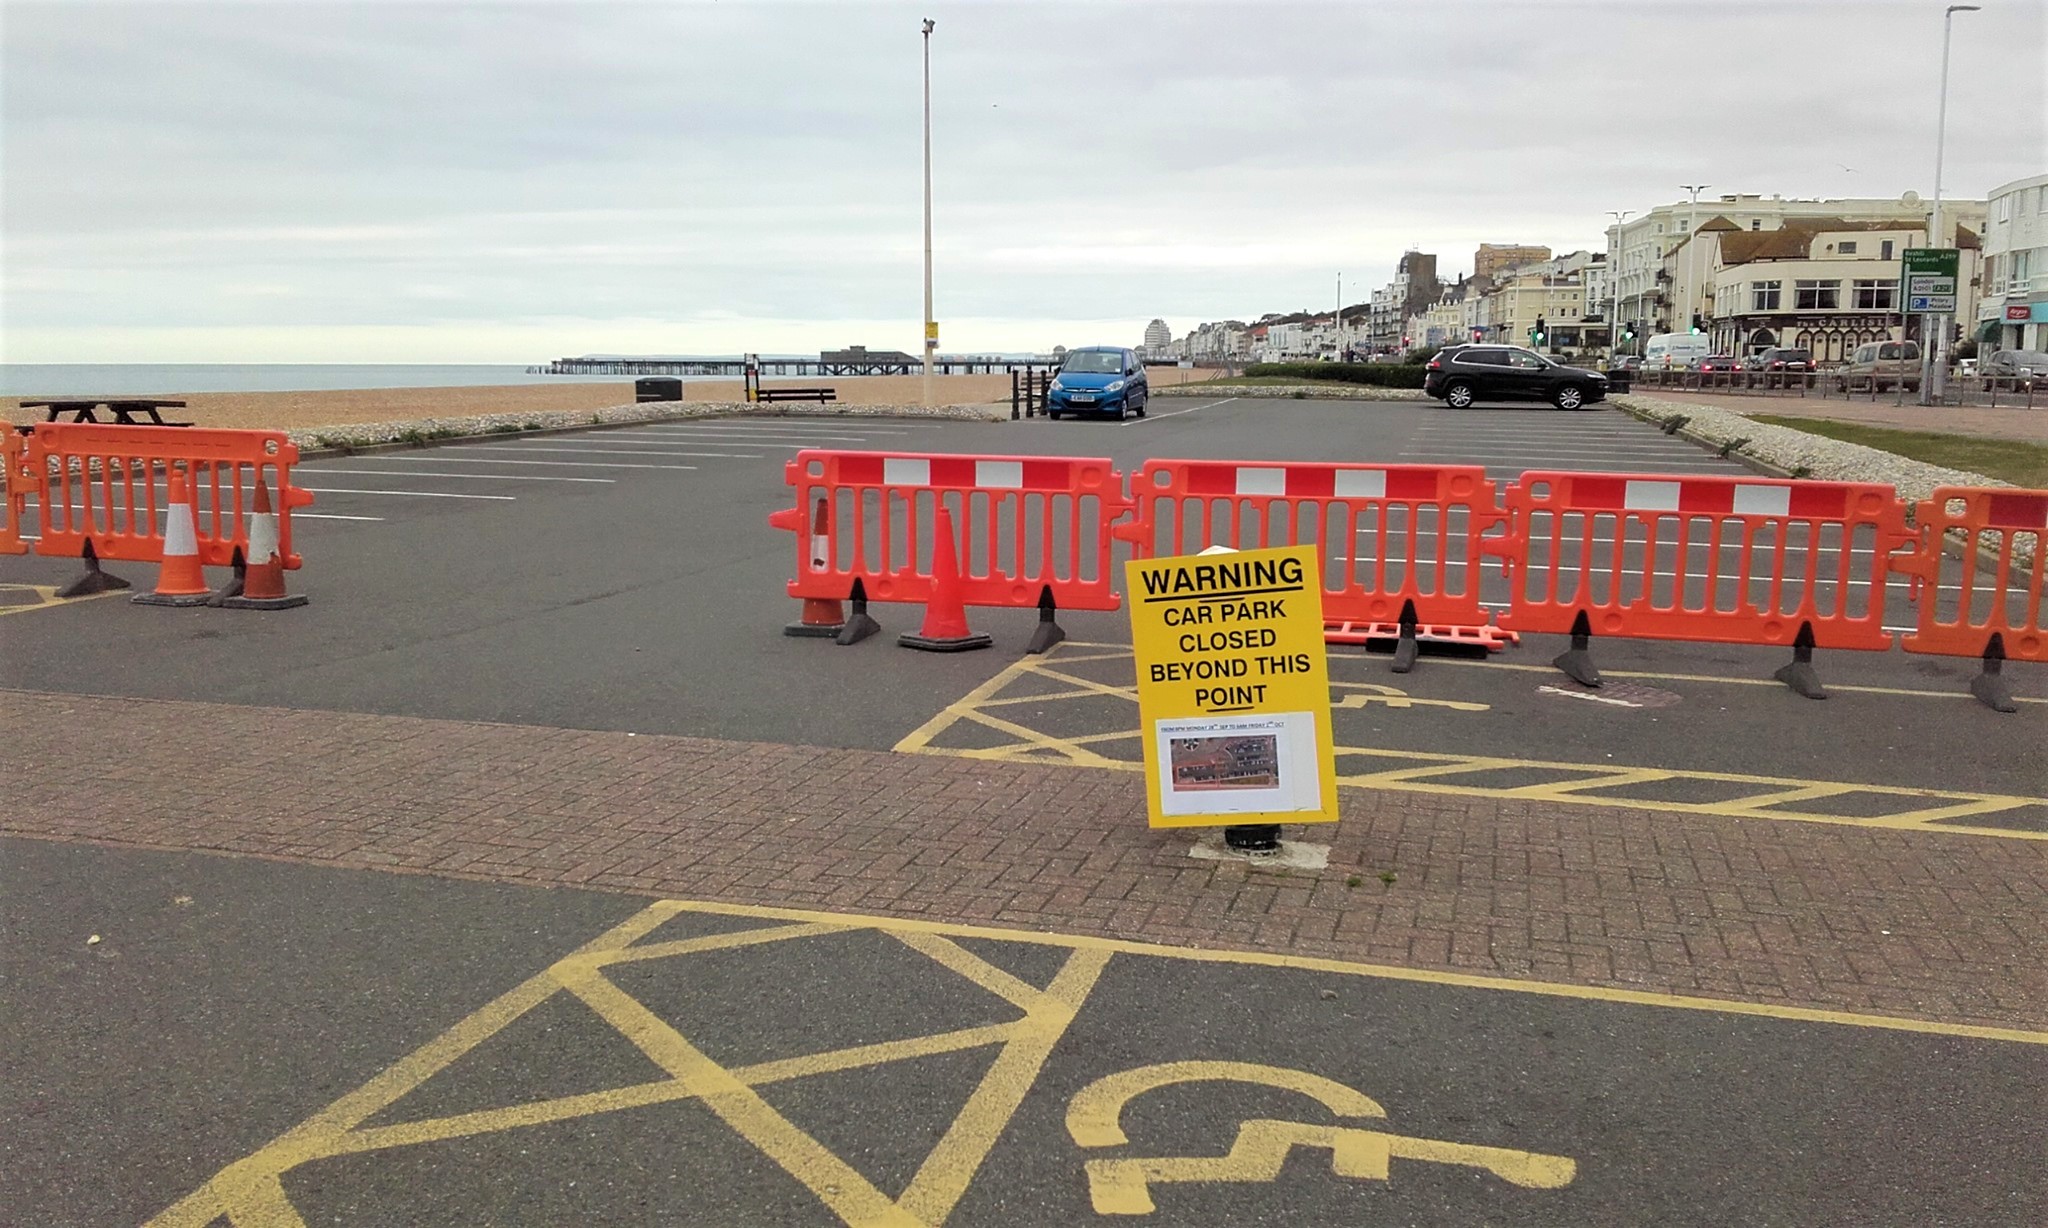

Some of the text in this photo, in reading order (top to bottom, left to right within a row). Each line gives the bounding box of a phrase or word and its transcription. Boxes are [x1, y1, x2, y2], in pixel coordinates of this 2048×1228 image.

[1913, 298, 1921, 308] P
[1818, 319, 1895, 327] CARLISLE
[1141, 558, 1304, 595] WARNING
[1164, 599, 1287, 627] CAR PARK
[1179, 628, 1277, 652] CLOSED
[1150, 654, 1311, 682] BEYOND THIS
[1195, 685, 1267, 707] POINT
